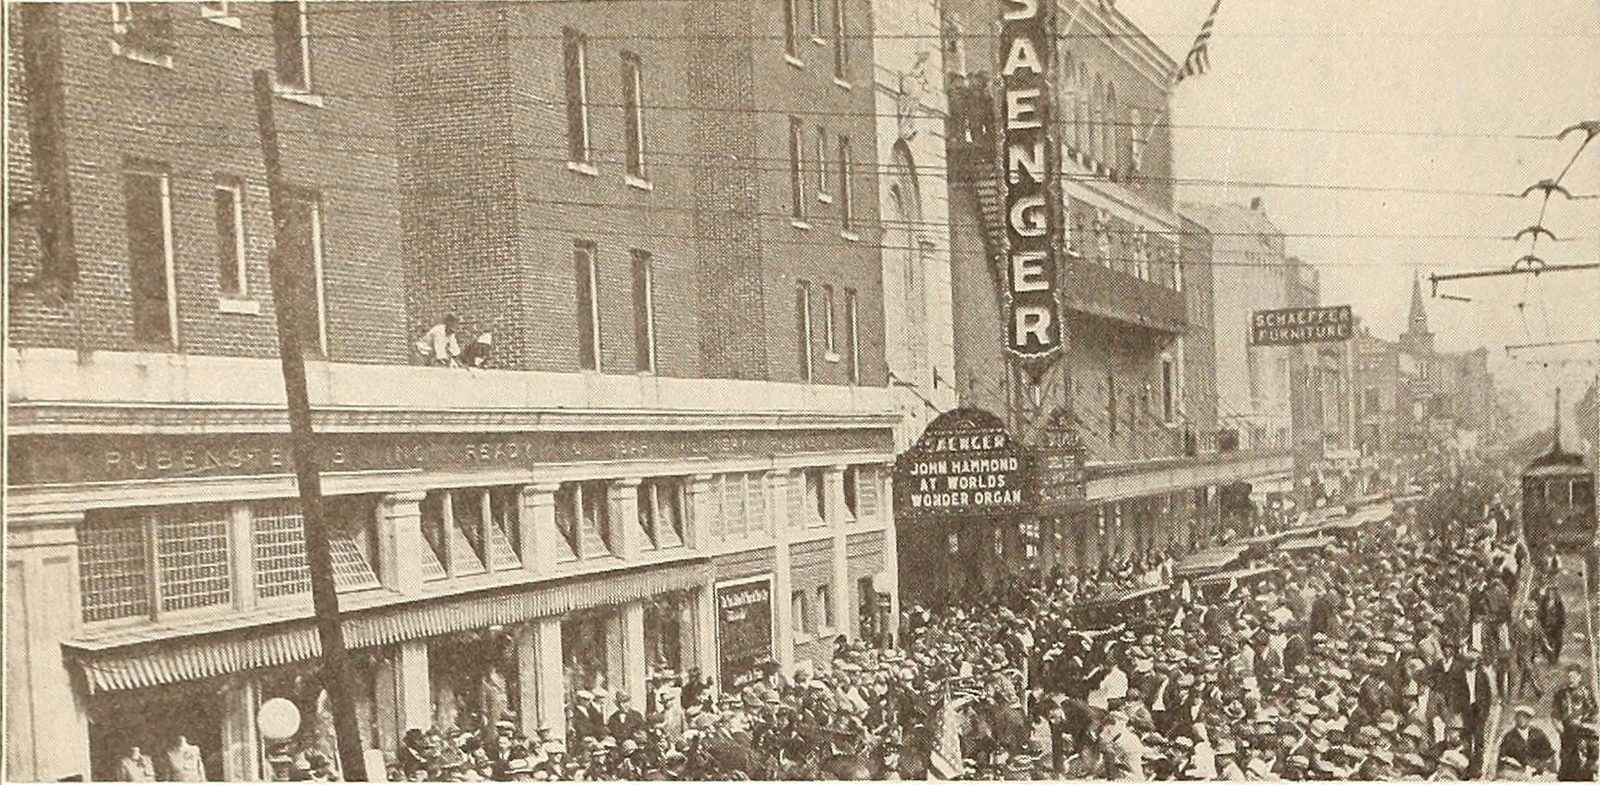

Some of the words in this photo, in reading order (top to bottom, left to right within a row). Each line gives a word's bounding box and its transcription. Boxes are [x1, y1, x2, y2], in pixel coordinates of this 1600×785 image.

[1256, 310, 1350, 327] SCHAEFFER
[1259, 324, 1348, 341] FURNITURE
[910, 461, 947, 475] JOHN
[951, 457, 1018, 474] HAMMOND
[920, 477, 937, 491] AT
[947, 475, 1005, 490] WORLDS
[911, 493, 969, 507] WONDER
[975, 490, 1021, 505] ORGAN
